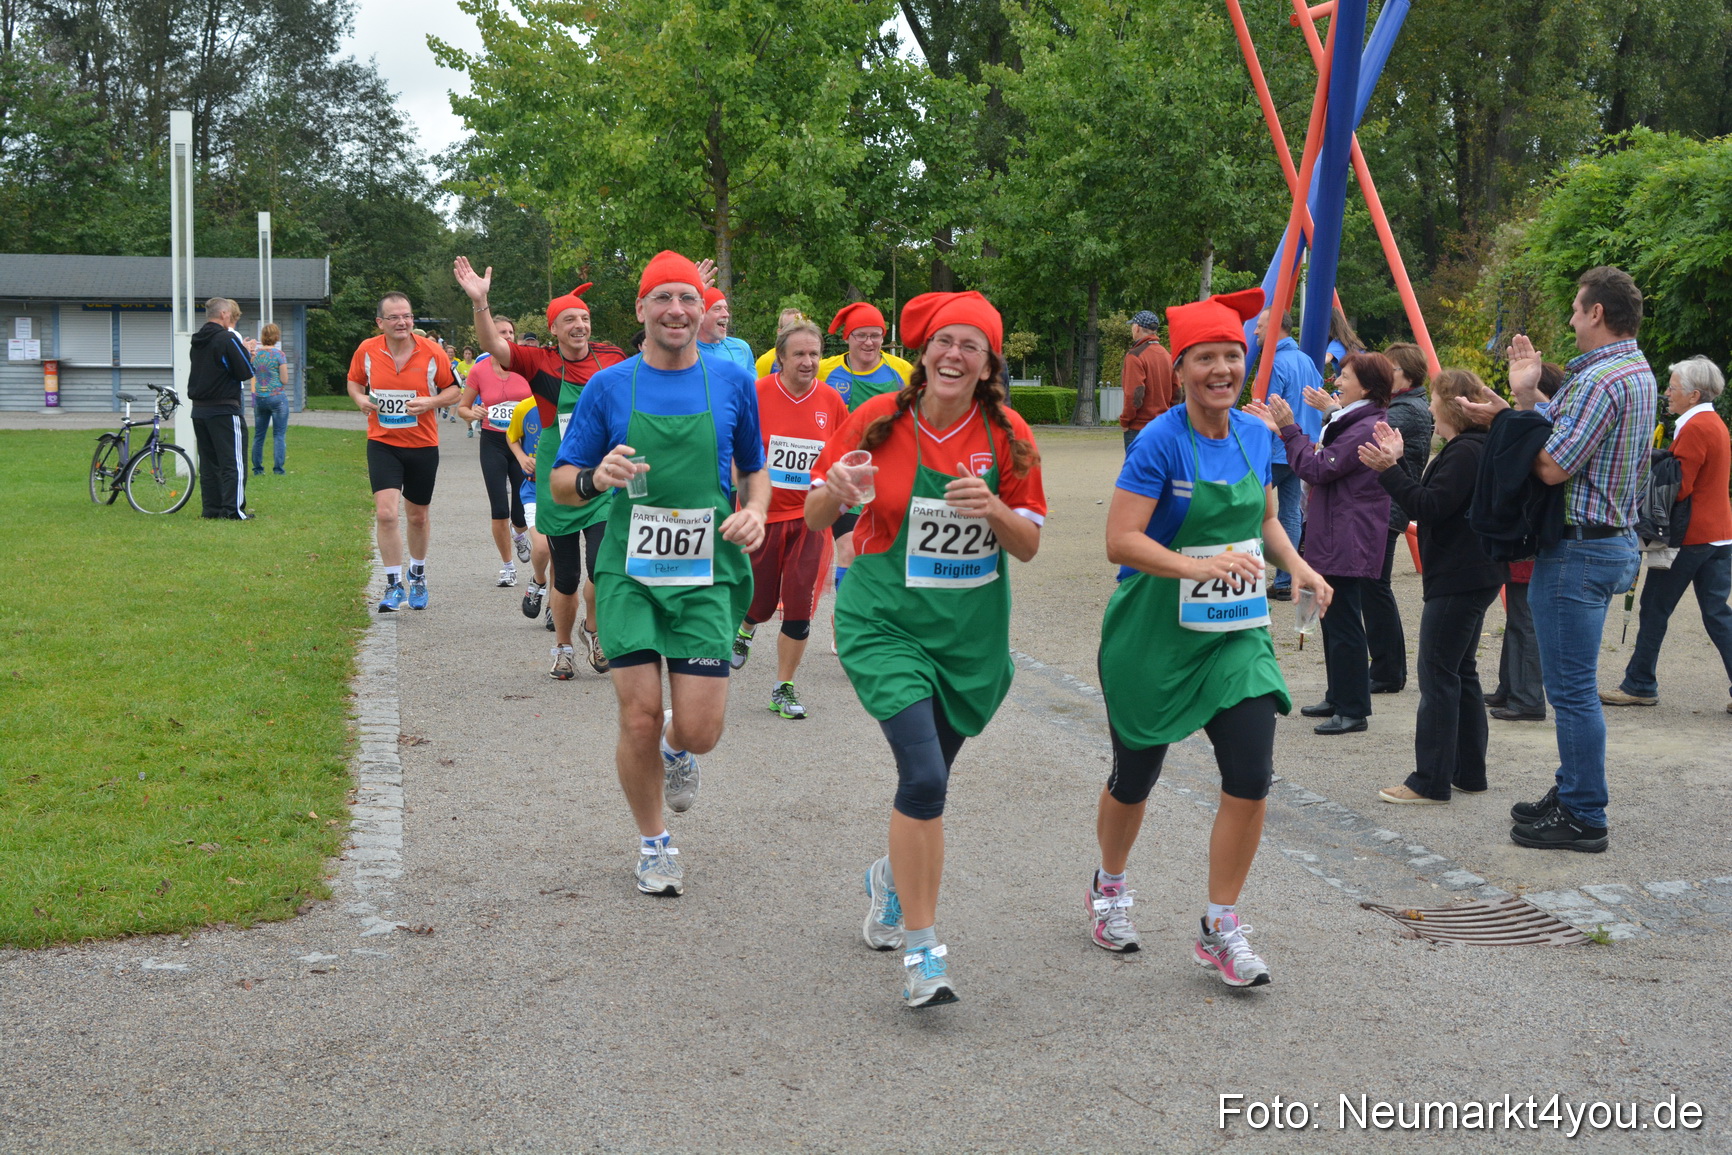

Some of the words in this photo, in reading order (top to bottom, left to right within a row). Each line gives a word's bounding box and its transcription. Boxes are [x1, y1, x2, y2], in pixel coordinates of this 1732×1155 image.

[492, 407, 514, 419] 288
[770, 440, 789, 448] PARTL
[772, 449, 819, 471] 2087
[784, 474, 802, 483] Reto
[632, 512, 660, 523] PARTL
[662, 515, 702, 525] Neumarkt
[912, 506, 947, 518] PARTL
[636, 525, 706, 556] 2067
[919, 521, 999, 555] 2224
[654, 563, 680, 574] Peter
[933, 562, 981, 579] Brigitte
[1207, 604, 1249, 620] Carolin
